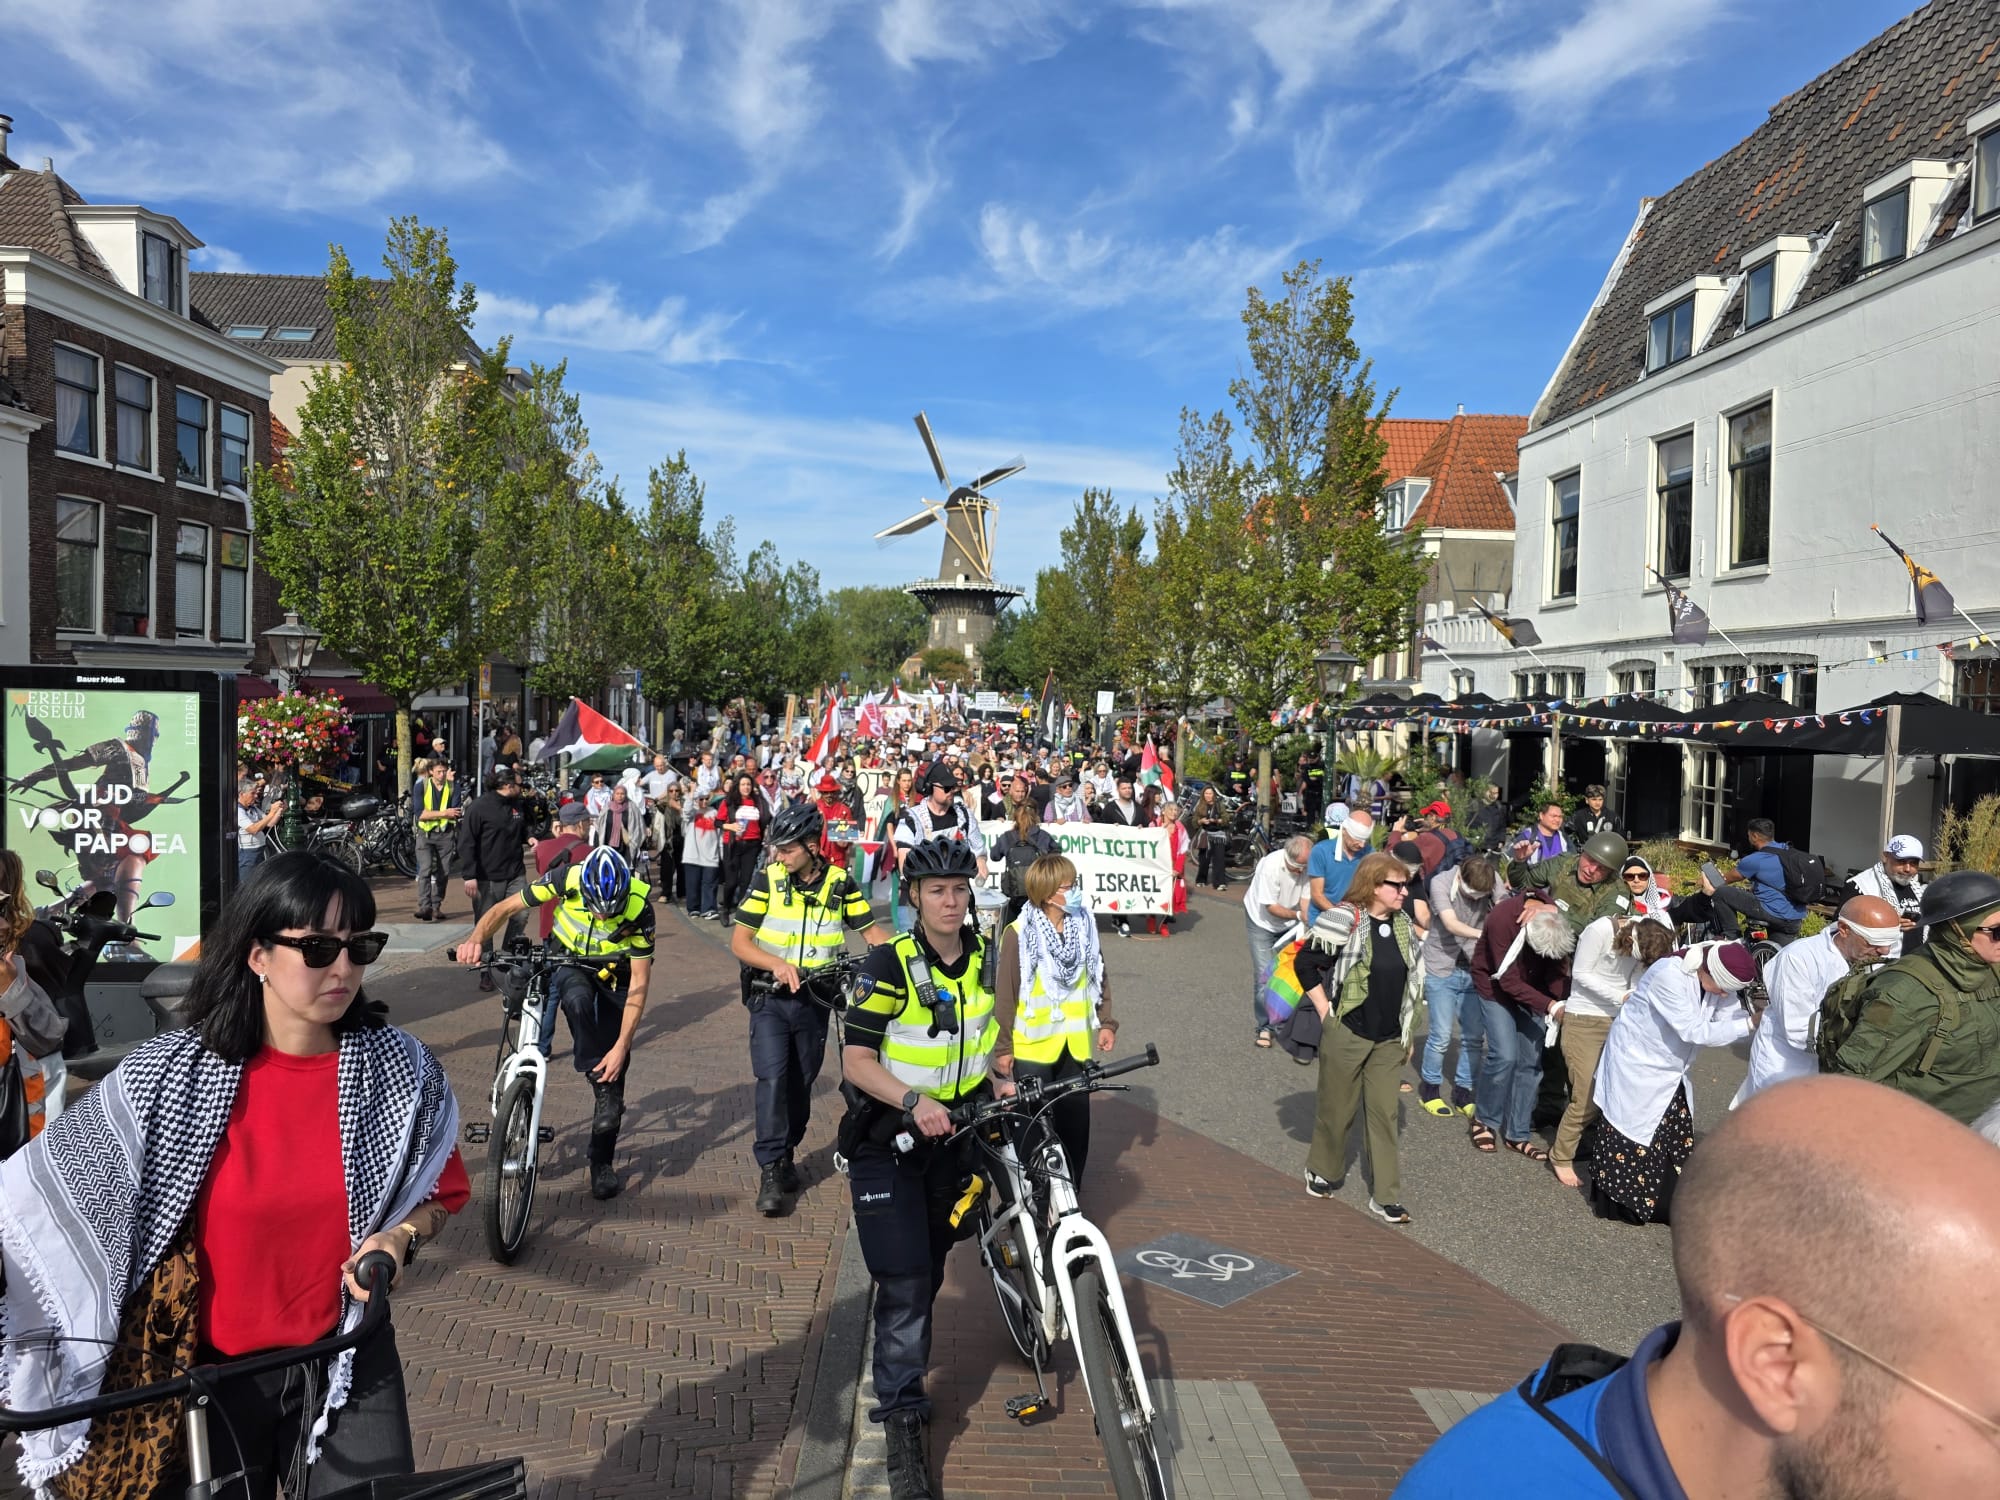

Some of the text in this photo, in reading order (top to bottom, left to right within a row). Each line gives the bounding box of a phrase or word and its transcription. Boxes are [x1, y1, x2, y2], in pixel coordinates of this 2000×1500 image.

[76, 675, 125, 684] Bauer Media
[185, 695, 197, 745] LEIDEN
[74, 783, 133, 805] TIJD
[19, 808, 103, 830] VOOR
[75, 833, 188, 854] PAPOEA
[1095, 873, 1161, 892] ISRAEL
